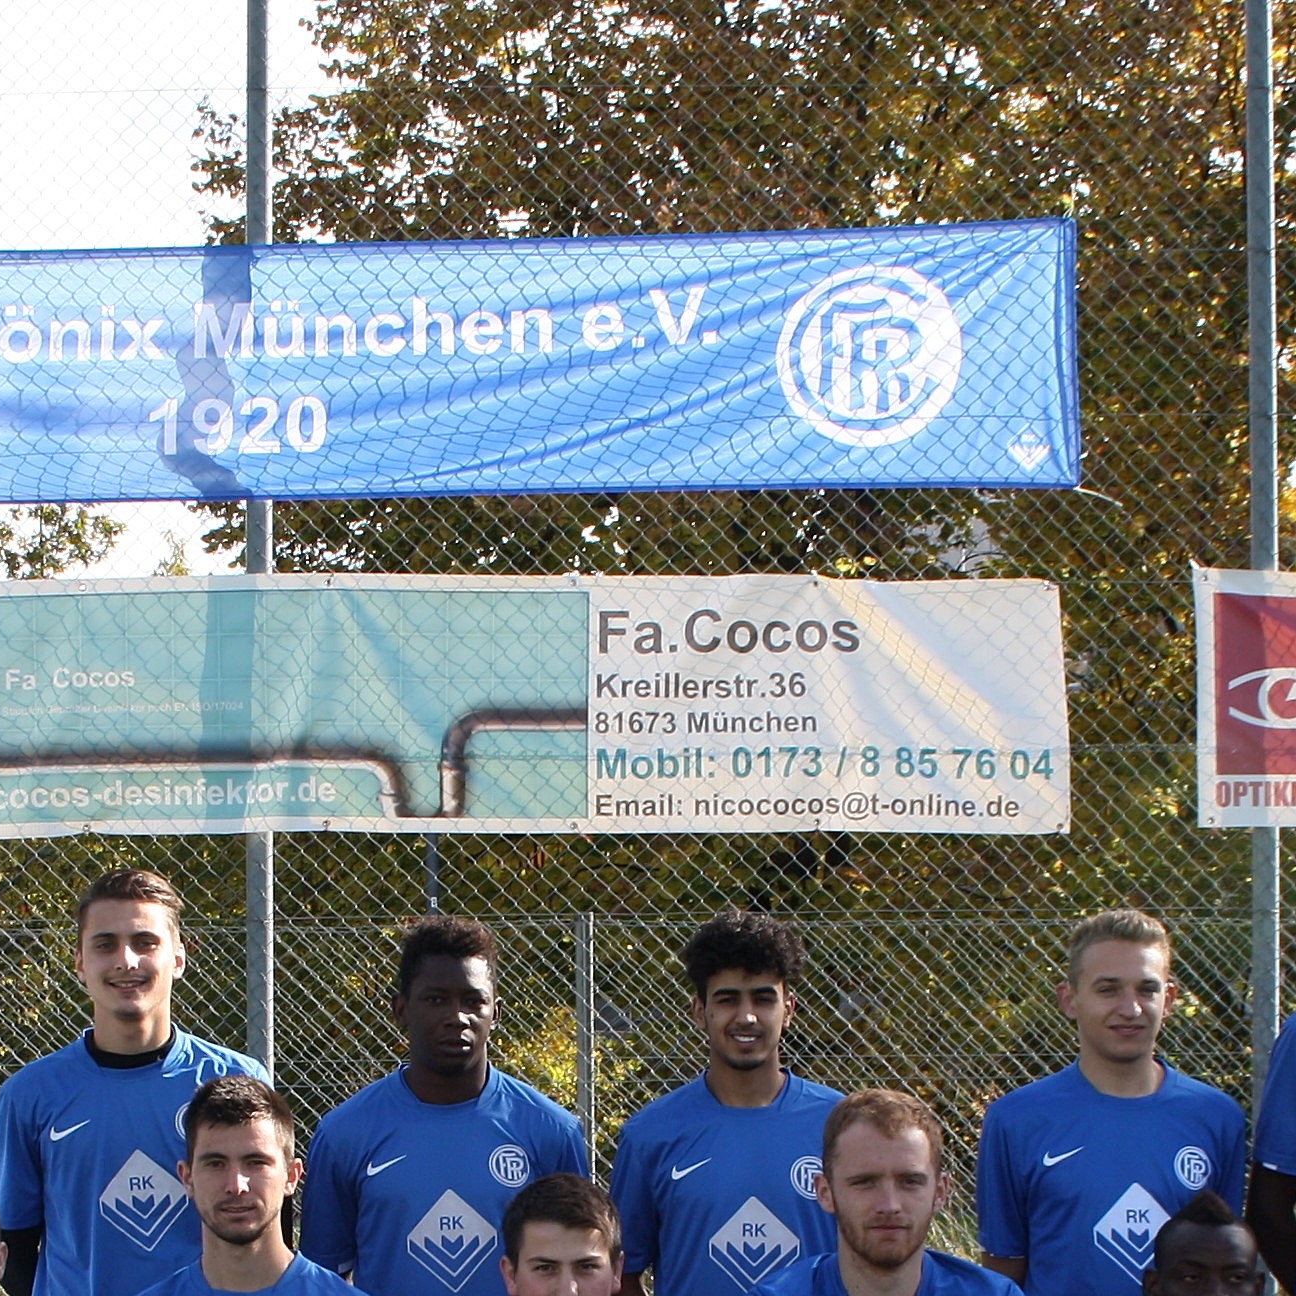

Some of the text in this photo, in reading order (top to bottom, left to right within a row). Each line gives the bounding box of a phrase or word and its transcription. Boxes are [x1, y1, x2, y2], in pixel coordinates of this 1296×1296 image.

[192, 298, 556, 360] München
[581, 286, 717, 351] e.V.
[147, 396, 329, 457] 1920
[597, 608, 861, 655] Fa.Cocos
[5, 666, 135, 690] Fa Cocos
[595, 672, 806, 699] Kreillerstr.36
[594, 711, 817, 735] 81673 München
[596, 745, 1055, 780] Mobil: 0173 / 8 85 76 04
[594, 792, 1020, 820] Email: nicococos@t-online.de
[128, 1175, 155, 1191] RK
[438, 1215, 464, 1231] RK
[1125, 1208, 1151, 1224] RK
[741, 1222, 767, 1238] RK
